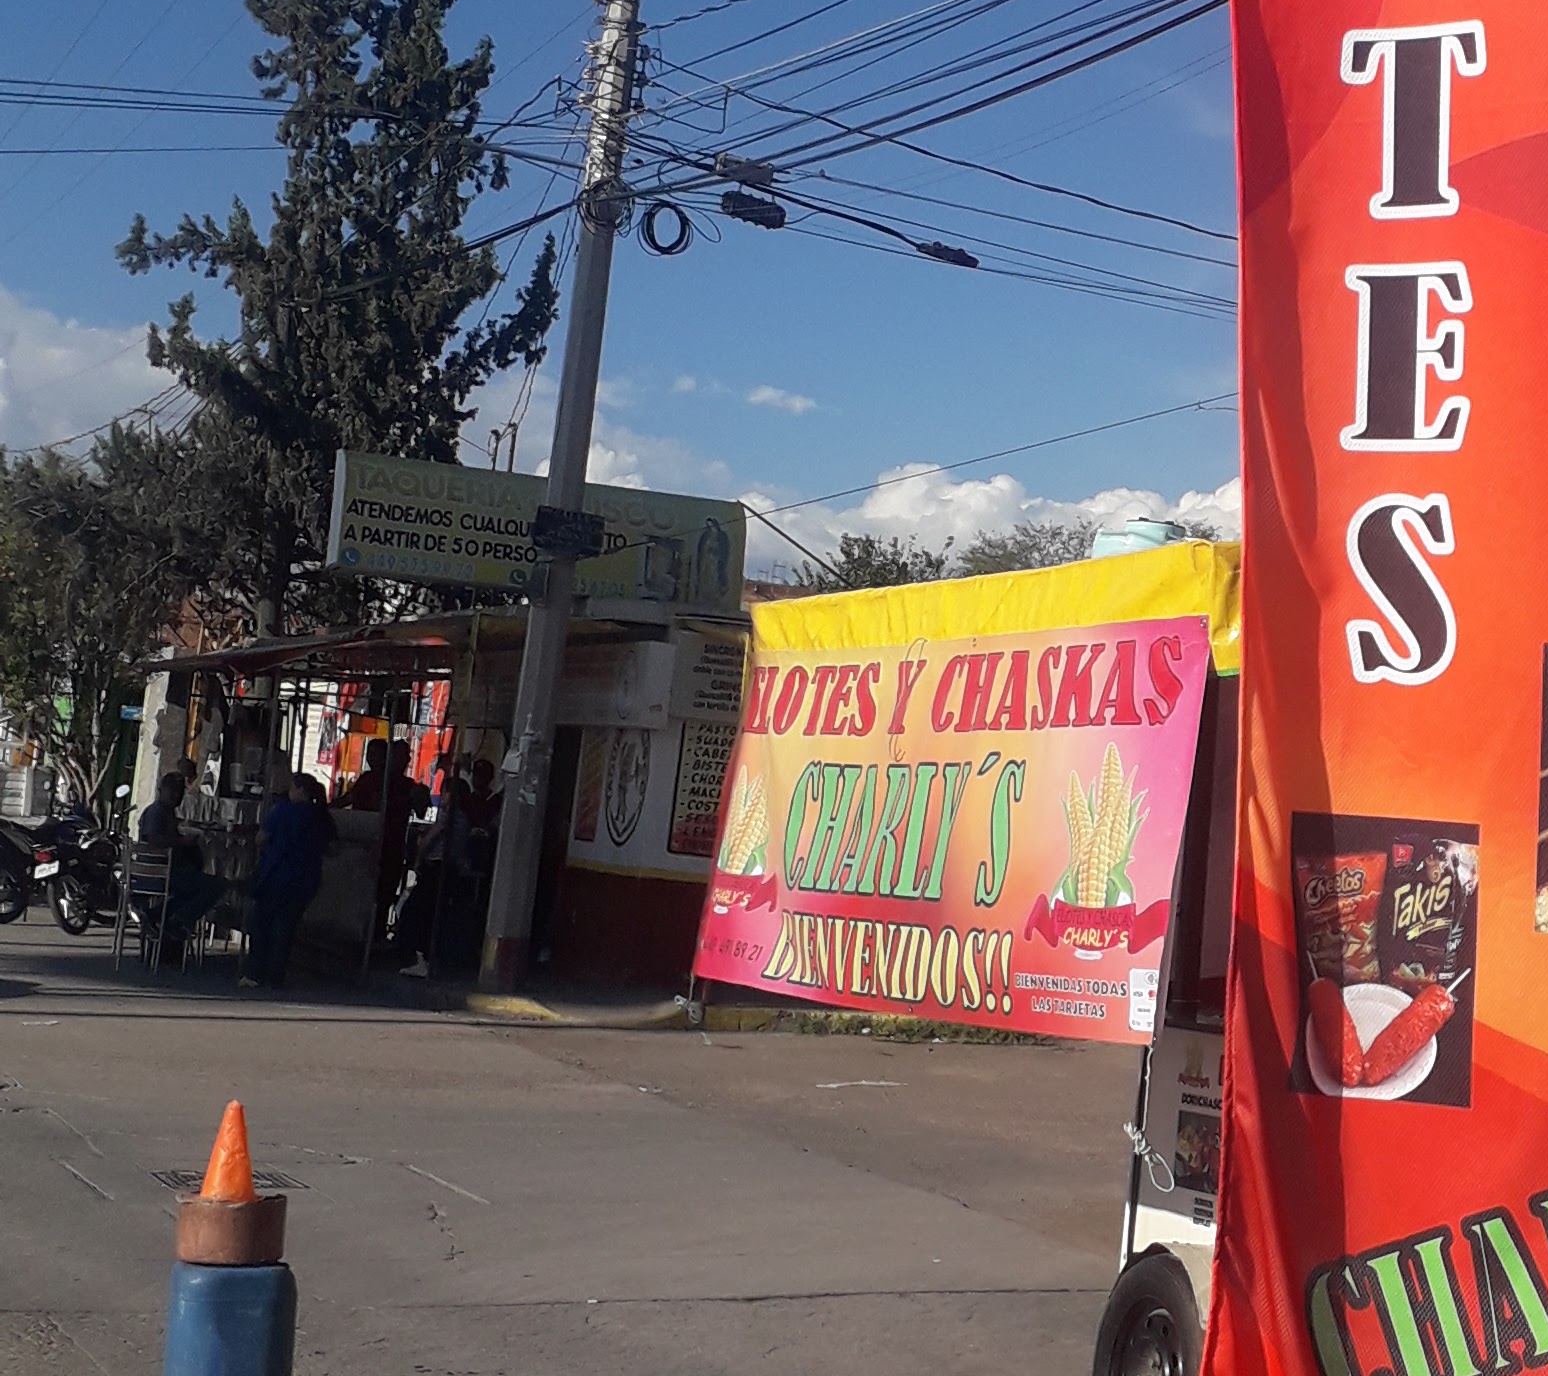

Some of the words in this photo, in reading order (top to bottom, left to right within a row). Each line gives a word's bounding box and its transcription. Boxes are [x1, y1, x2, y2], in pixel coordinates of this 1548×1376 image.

[347, 497, 452, 528] ATENDEMOS
[460, 512, 531, 538] CUALQU
[344, 523, 357, 542] A
[361, 525, 421, 551] PARTIR
[424, 534, 447, 552] DE
[451, 536, 477, 556] 50
[482, 541, 538, 563] PERSO
[888, 659, 927, 736] Y
[931, 636, 1183, 733] CHASKAS
[698, 724, 737, 735] PASTO
[692, 758, 728, 772] BISTE
[694, 747, 731, 759] CABE
[691, 770, 724, 785] CHOR
[687, 800, 719, 812] COST
[1304, 866, 1365, 908] Cheetos
[1393, 876, 1452, 936] Takis
[761, 910, 1013, 1016] BIENVENIDOS!!
[1015, 973, 1083, 993] BIENVENIDAS
[1085, 981, 1127, 997] TODAS
[1032, 997, 1051, 1012] LAS
[1054, 998, 1105, 1018] TARJETAS
